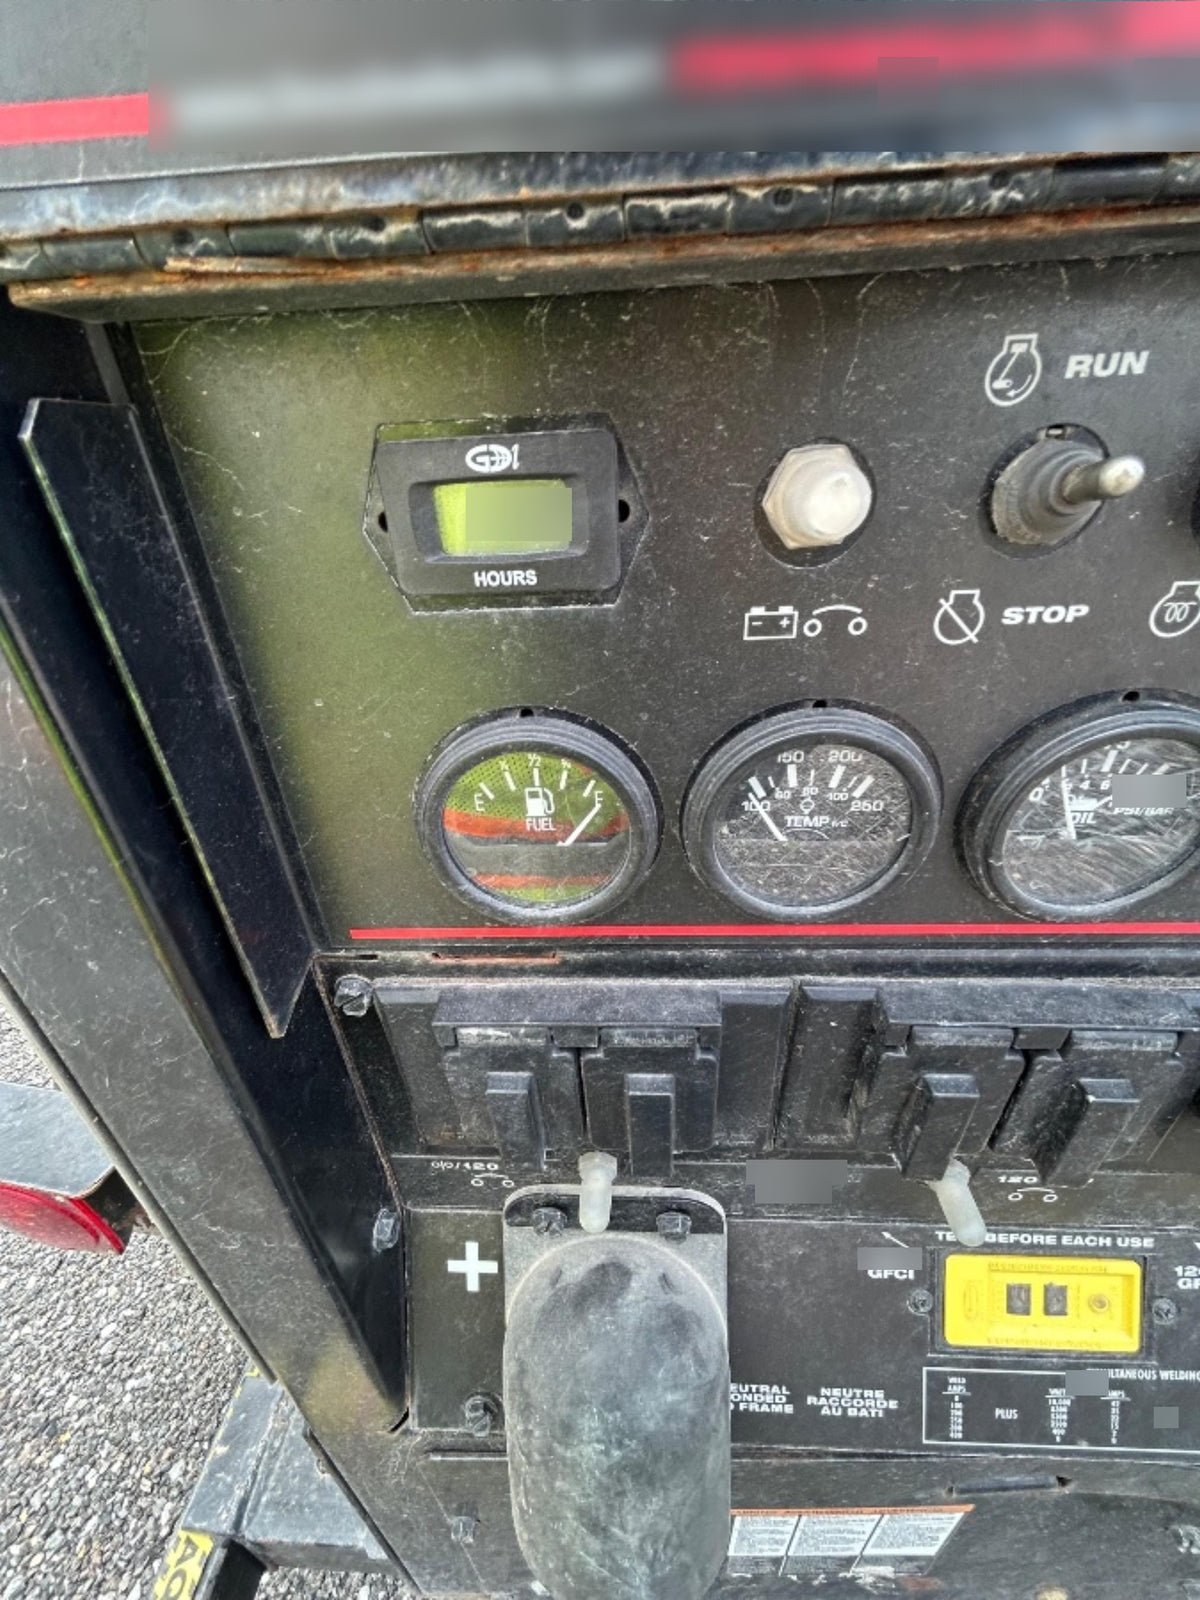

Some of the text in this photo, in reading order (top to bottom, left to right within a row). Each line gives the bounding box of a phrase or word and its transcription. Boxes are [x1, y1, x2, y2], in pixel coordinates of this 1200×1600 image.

[1064, 351, 1149, 379] RUN
[473, 569, 538, 587] HOURS
[1001, 604, 1090, 625] STOP
[777, 751, 804, 763] 150
[828, 750, 863, 763] 200
[473, 793, 486, 812] E
[740, 799, 771, 812] 100
[850, 800, 885, 812] 250
[525, 817, 556, 832] FUEL
[784, 815, 830, 828] TEMP
[935, 1230, 1155, 1248] TE BEFORE EACH USE
[867, 1269, 915, 1280] GFCI
[1174, 1265, 1200, 1277] 12
[1108, 1368, 1157, 1380] LTANEOUS
[730, 1383, 791, 1395] EUTRAL
[820, 1387, 885, 1399] NEUTRE
[730, 1393, 787, 1403] ONDED
[806, 1395, 899, 1409] RACCORDE
[739, 1402, 794, 1414] FRAME
[820, 1405, 842, 1416] AU
[995, 1408, 1018, 1419] PLUS
